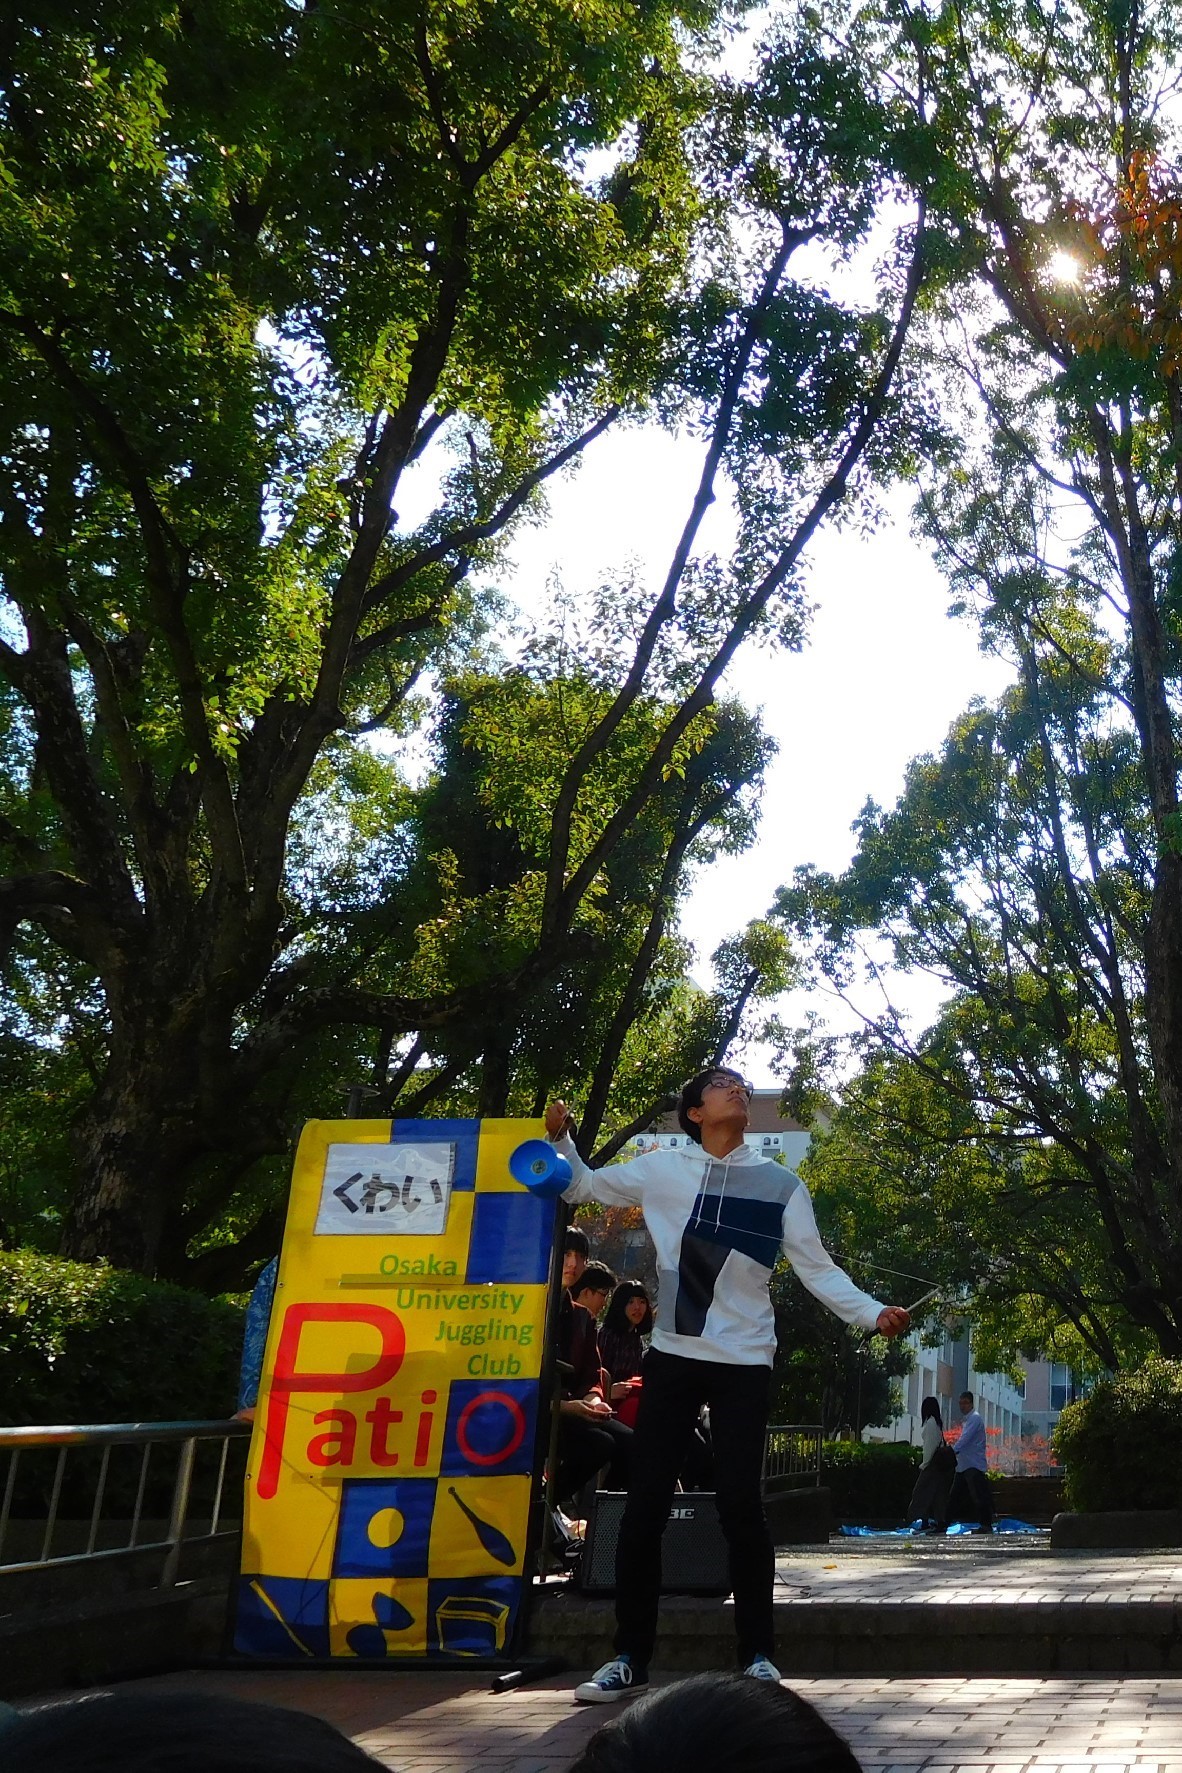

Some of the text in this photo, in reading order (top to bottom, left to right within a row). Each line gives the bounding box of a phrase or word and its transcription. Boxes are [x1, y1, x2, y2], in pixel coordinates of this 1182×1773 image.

[333, 1172, 443, 1214] くわい
[379, 1253, 458, 1276] Osaka
[396, 1287, 525, 1314] University
[434, 1317, 535, 1346] Juggling
[467, 1353, 522, 1376] Club
